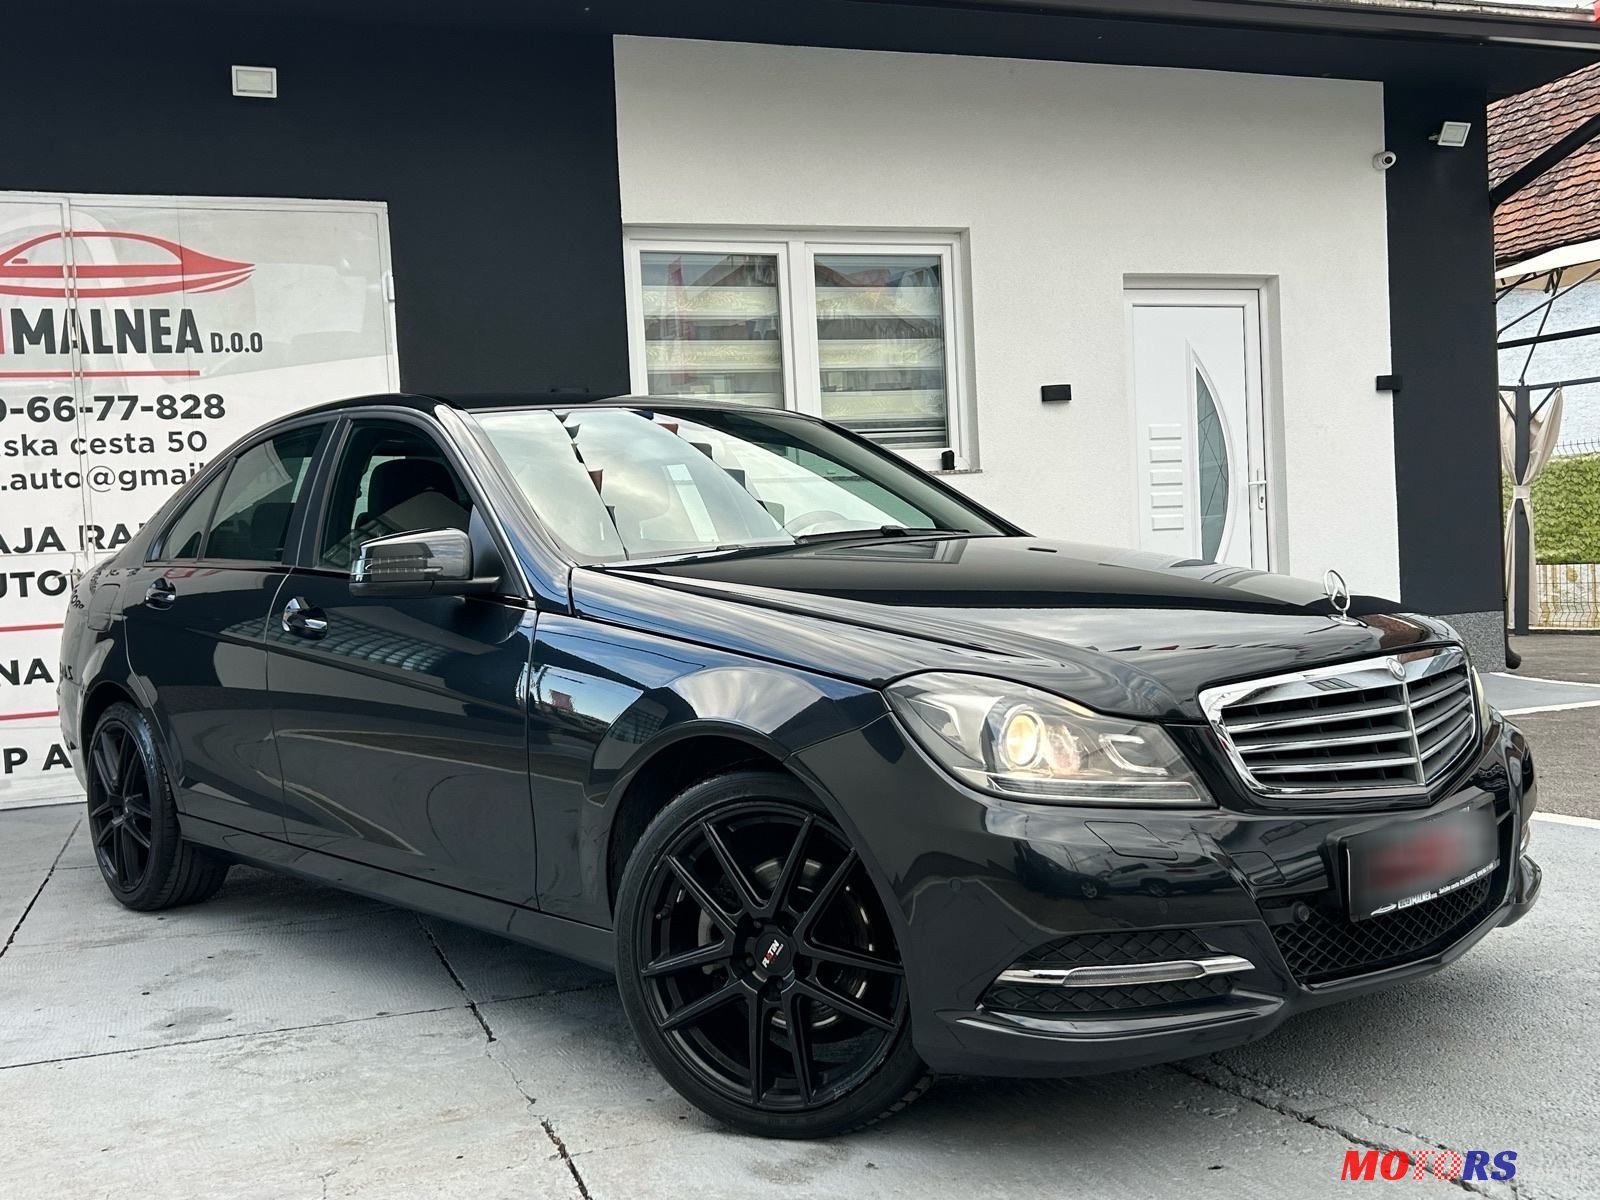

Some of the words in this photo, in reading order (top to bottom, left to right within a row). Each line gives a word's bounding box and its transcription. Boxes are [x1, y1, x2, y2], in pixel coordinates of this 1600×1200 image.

[0, 433, 58, 457] ska
[70, 432, 155, 456] cesta
[167, 430, 208, 453] 50
[78, 522, 146, 551] RA
